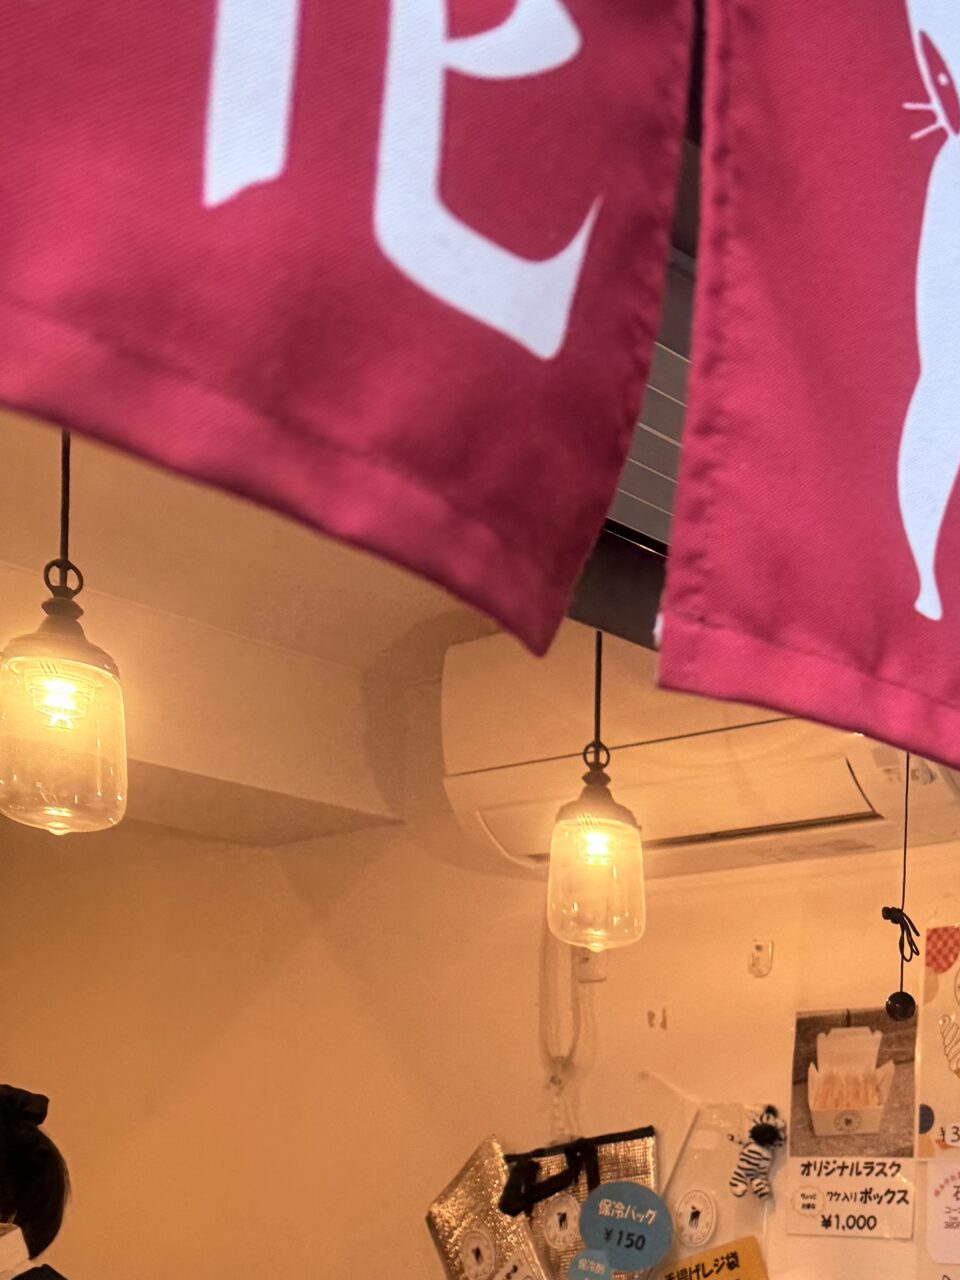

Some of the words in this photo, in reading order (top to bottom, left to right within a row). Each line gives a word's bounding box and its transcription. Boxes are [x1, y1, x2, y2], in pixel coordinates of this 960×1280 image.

[801, 1160, 901, 1177] オリジナルラスク
[598, 1198, 658, 1225] 保冷バッグ
[821, 1214, 878, 1231] ¥1,000
[603, 1227, 646, 1251] ¥150
